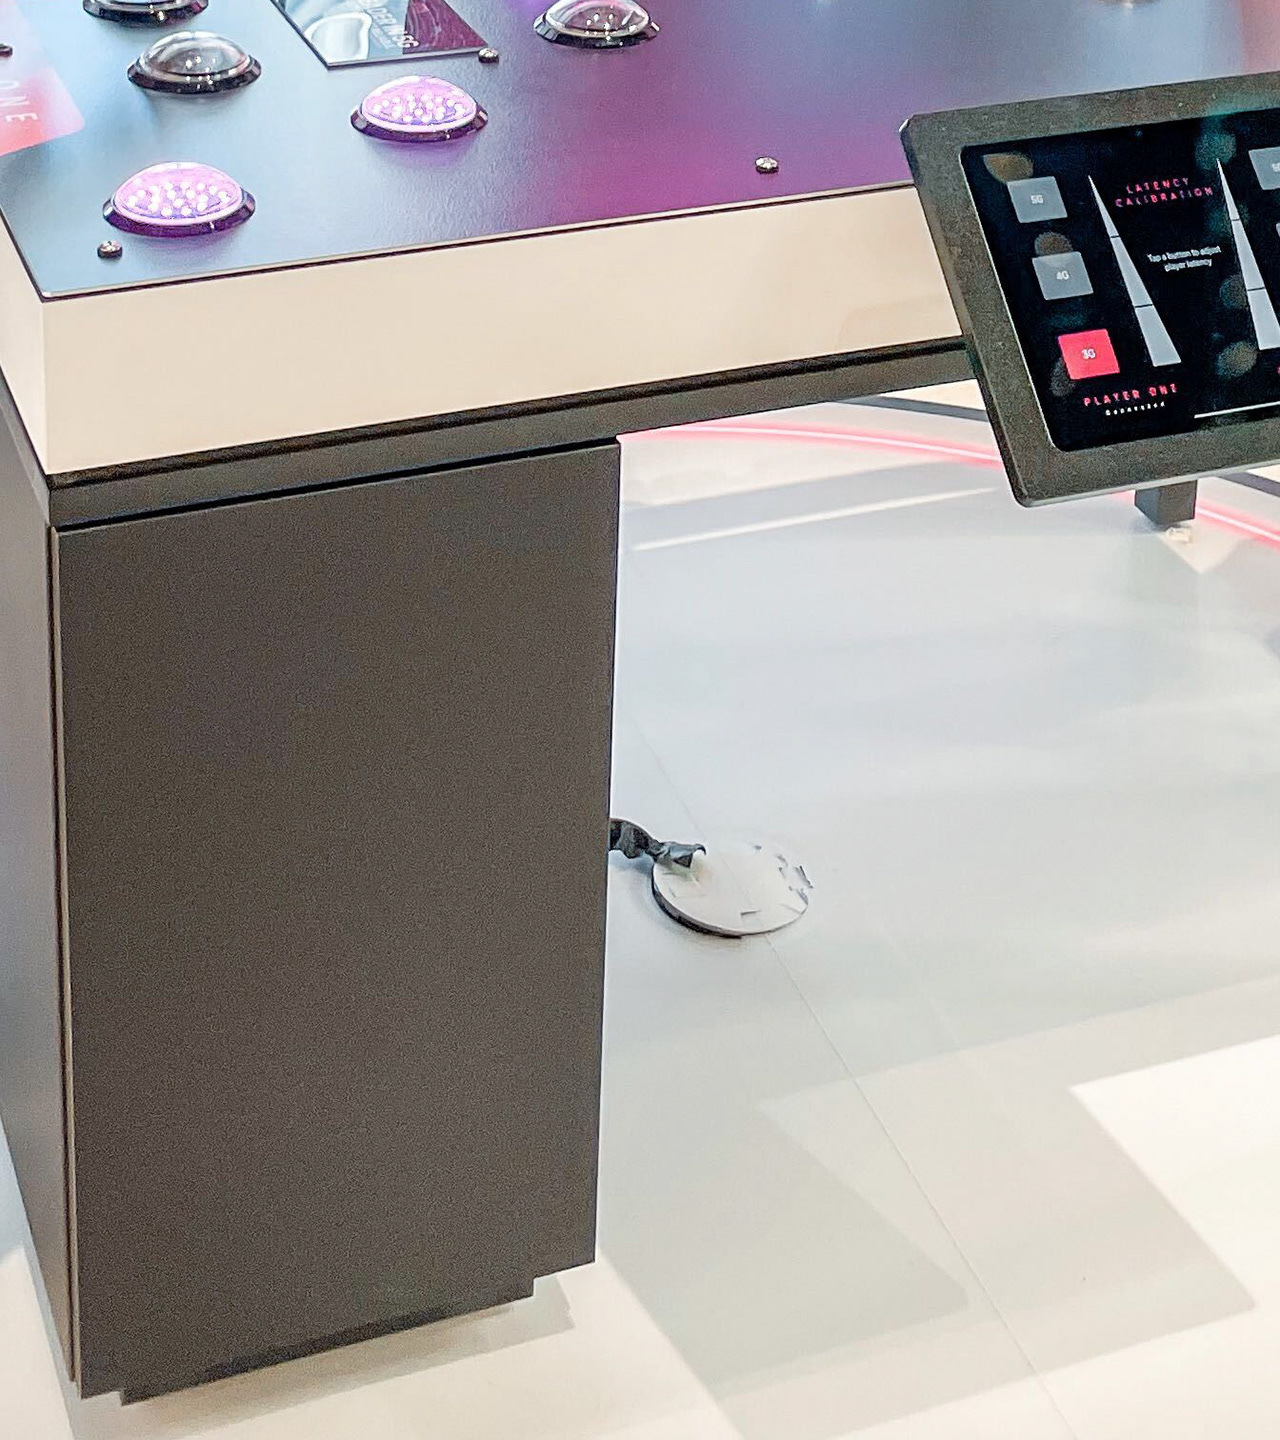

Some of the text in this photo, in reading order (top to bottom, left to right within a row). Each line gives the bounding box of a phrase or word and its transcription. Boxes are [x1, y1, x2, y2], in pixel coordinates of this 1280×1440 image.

[1126, 178, 1188, 194] LATENCY
[1030, 194, 1044, 205] 5G
[1115, 187, 1213, 207] CALIBRATION
[1056, 270, 1070, 281] 4G
[1081, 348, 1095, 359] 3G
[1083, 383, 1177, 406] PLAYER ONE
